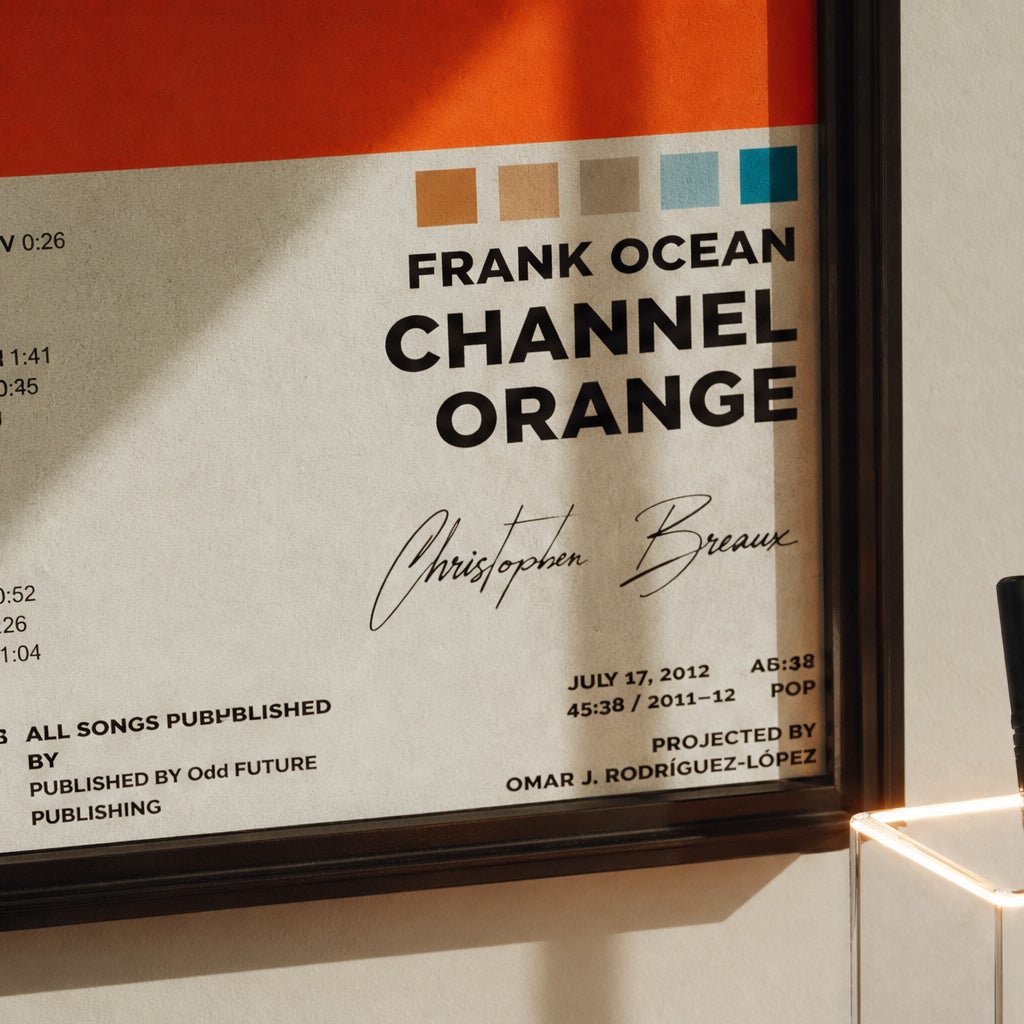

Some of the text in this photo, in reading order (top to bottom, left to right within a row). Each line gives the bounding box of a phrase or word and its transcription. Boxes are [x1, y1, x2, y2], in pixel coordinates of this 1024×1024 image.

[22, 231, 66, 251] 0:26
[409, 227, 797, 289] FRANK OCEAN
[385, 288, 798, 373] CHANNEL
[10, 346, 50, 366] 1:41
[436, 365, 798, 449] ORANGE
[620, 493, 798, 598] Breaux
[568, 664, 710, 691] JULY 17, 2012
[771, 680, 816, 698] POP
[567, 697, 625, 719] 45:38
[631, 694, 641, 713] /
[26, 724, 70, 742] ALL
[77, 714, 160, 737] SONGS
[652, 722, 817, 753] PROJECTED BY
[28, 752, 59, 770] BY
[506, 748, 817, 792] OMAR J. RODRÍGUEZ-LÓPEZ
[30, 755, 317, 797] PUBLISHED BY Odd FUTURE
[31, 799, 162, 825] PUBLISHING
